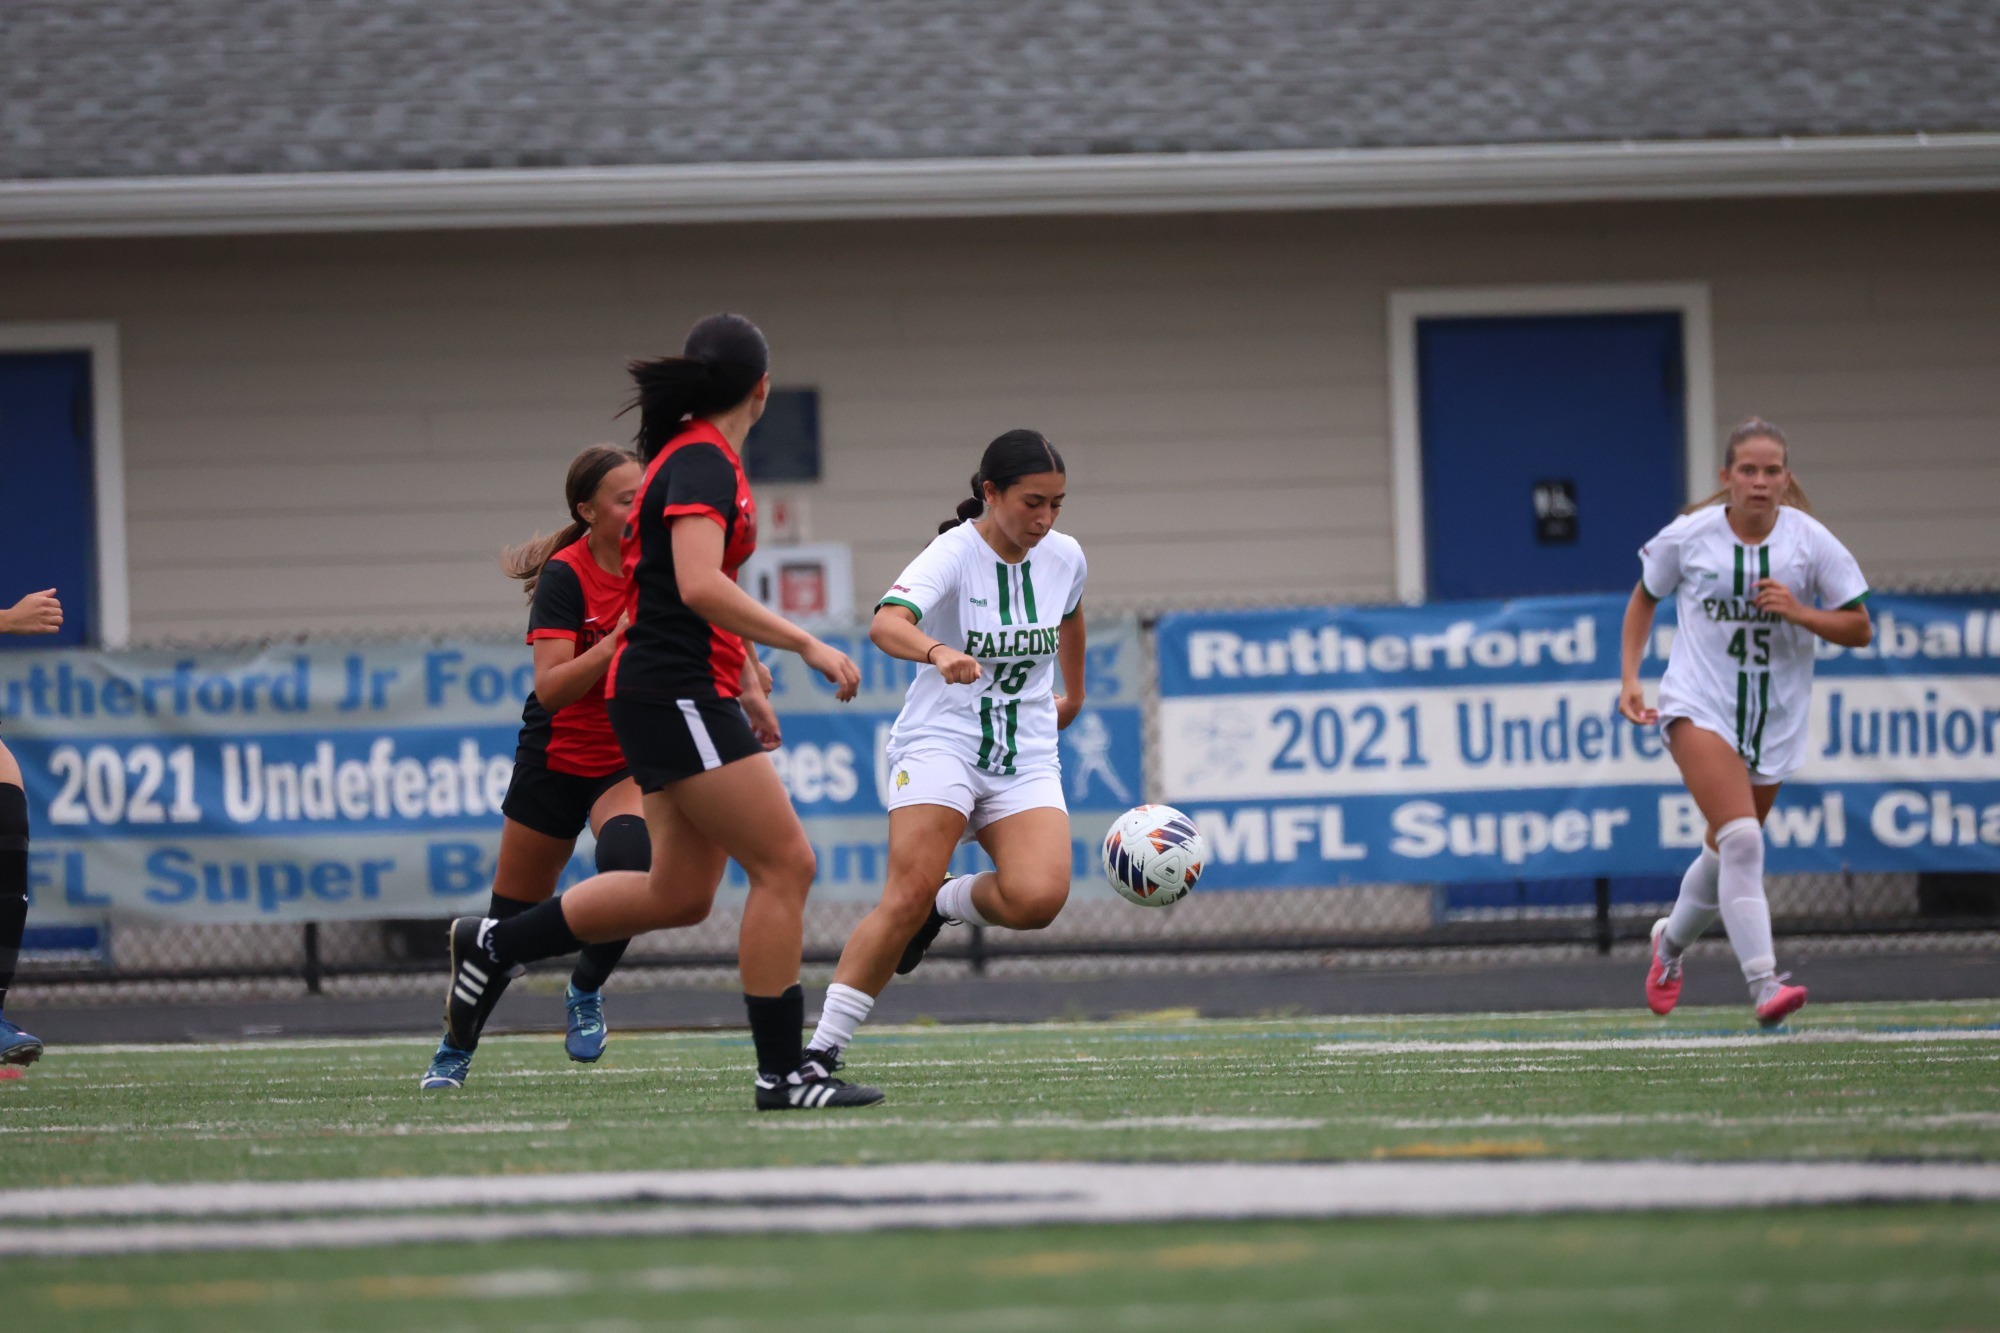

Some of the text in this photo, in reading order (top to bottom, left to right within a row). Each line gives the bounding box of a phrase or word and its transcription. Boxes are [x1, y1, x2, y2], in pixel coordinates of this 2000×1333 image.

[984, 660, 1037, 695] 16
[1187, 616, 1597, 680] Rutherford
[1727, 627, 1771, 667] 45
[337, 654, 398, 712] Jr
[1270, 690, 2000, 773] 2021 Undefe Junior
[48, 744, 202, 826] 2021
[221, 737, 516, 824] Undefeate
[1199, 804, 1368, 866] MFL
[1387, 798, 1630, 866] Super
[1658, 790, 1846, 848] Bwl
[28, 848, 112, 907] FL
[144, 846, 395, 912] Super
